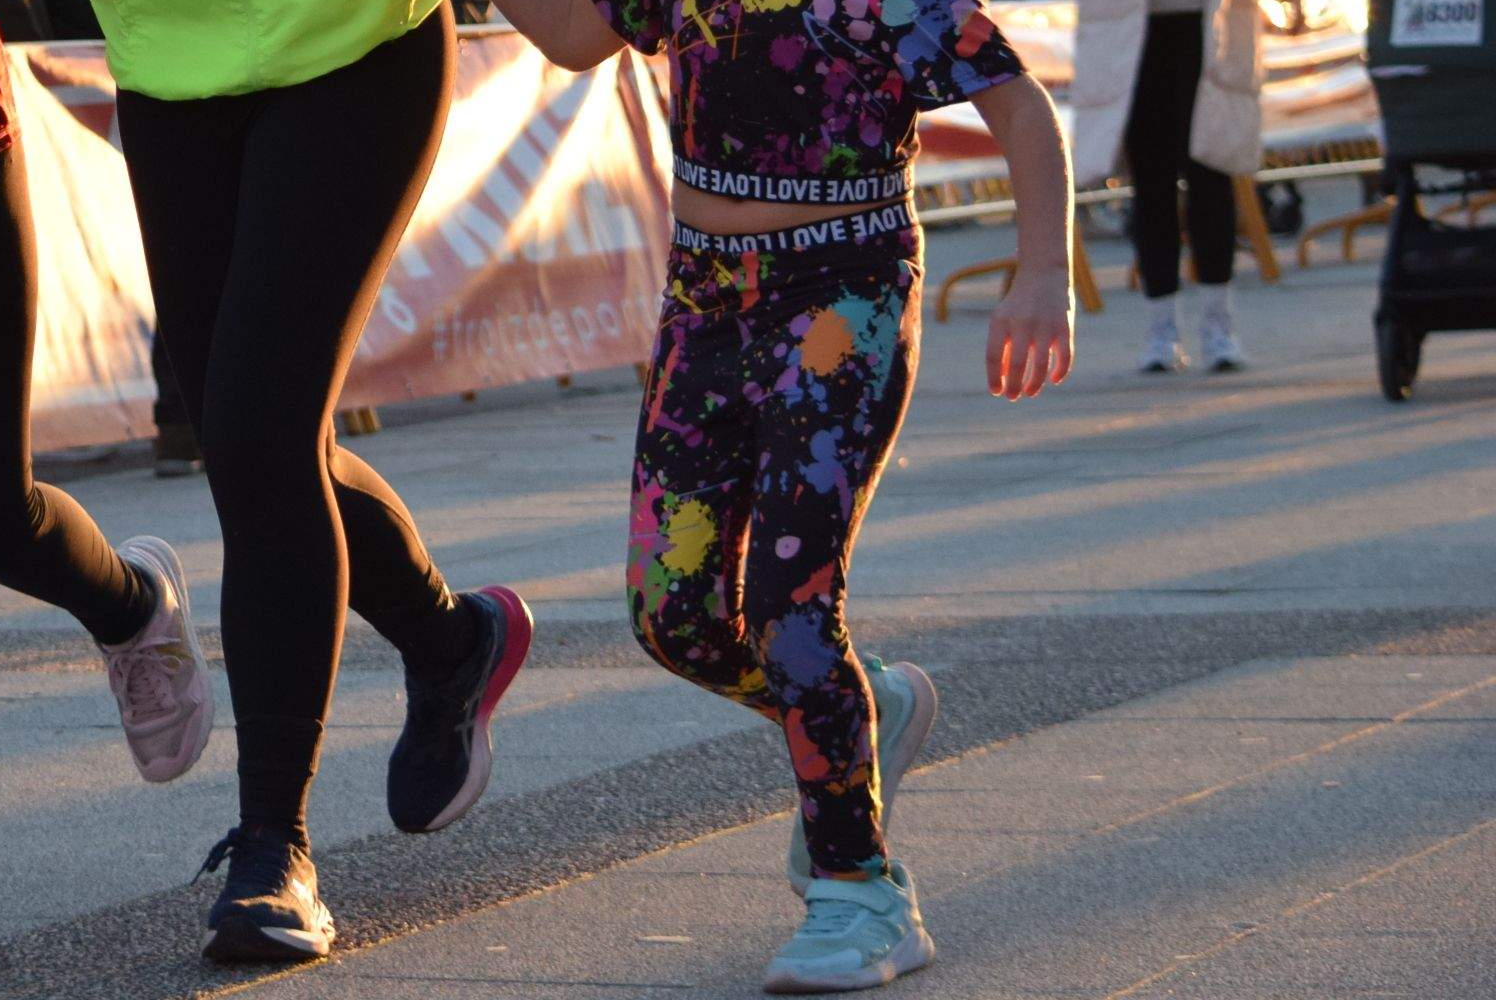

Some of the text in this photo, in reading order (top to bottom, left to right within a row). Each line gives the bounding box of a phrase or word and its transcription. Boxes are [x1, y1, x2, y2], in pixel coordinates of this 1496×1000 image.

[766, 177, 821, 202] LOVE
[826, 176, 879, 202] LOVE
[851, 205, 907, 237] LOVE
